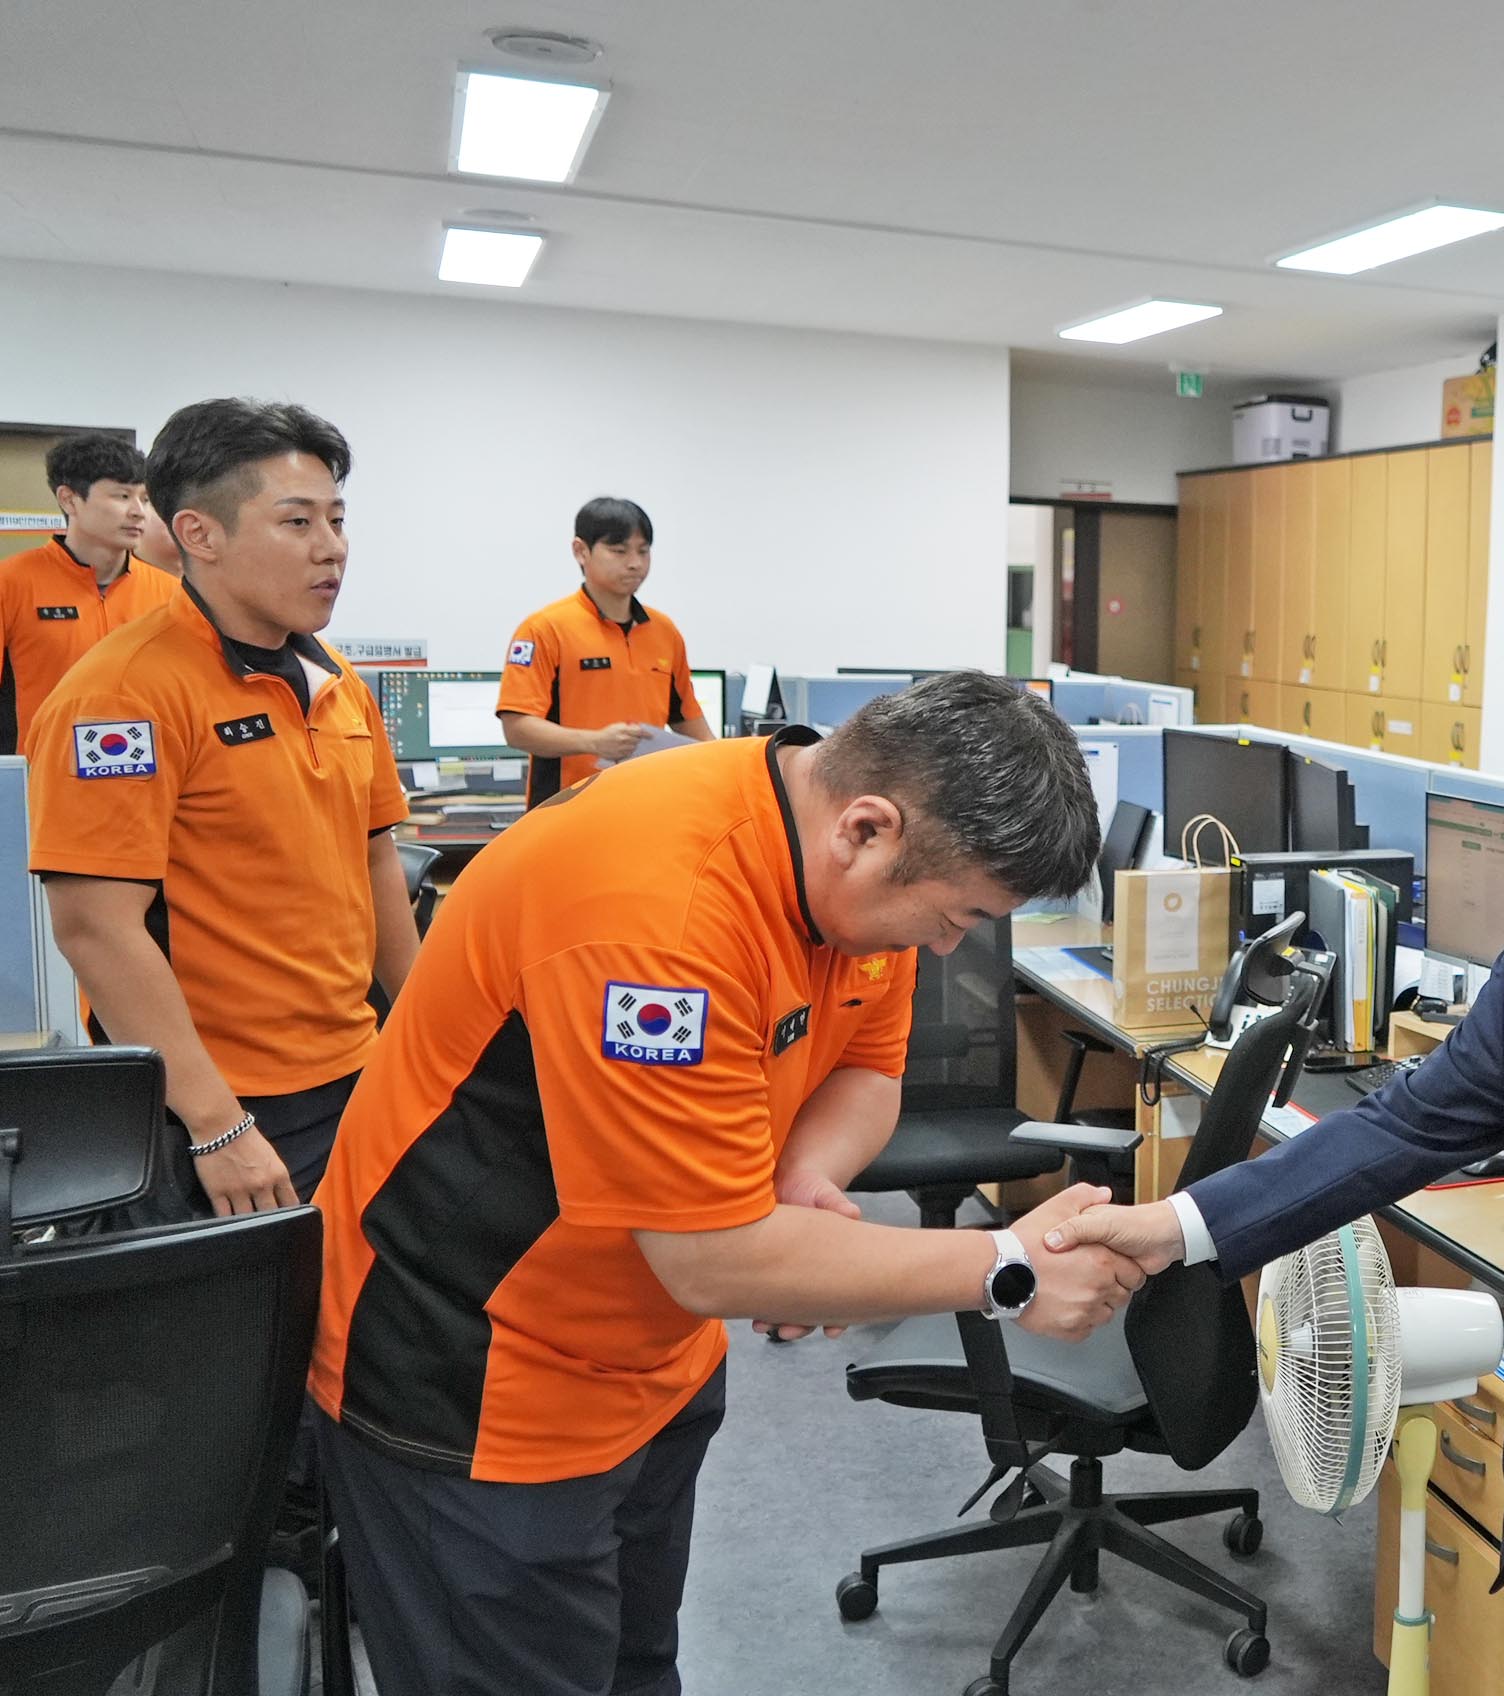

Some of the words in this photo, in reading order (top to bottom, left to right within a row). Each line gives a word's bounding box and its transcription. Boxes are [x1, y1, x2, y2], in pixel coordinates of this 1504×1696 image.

[86, 763, 148, 777] KOREA
[1147, 977, 1222, 994] CHUNGJ
[615, 1043, 692, 1062] KOREA
